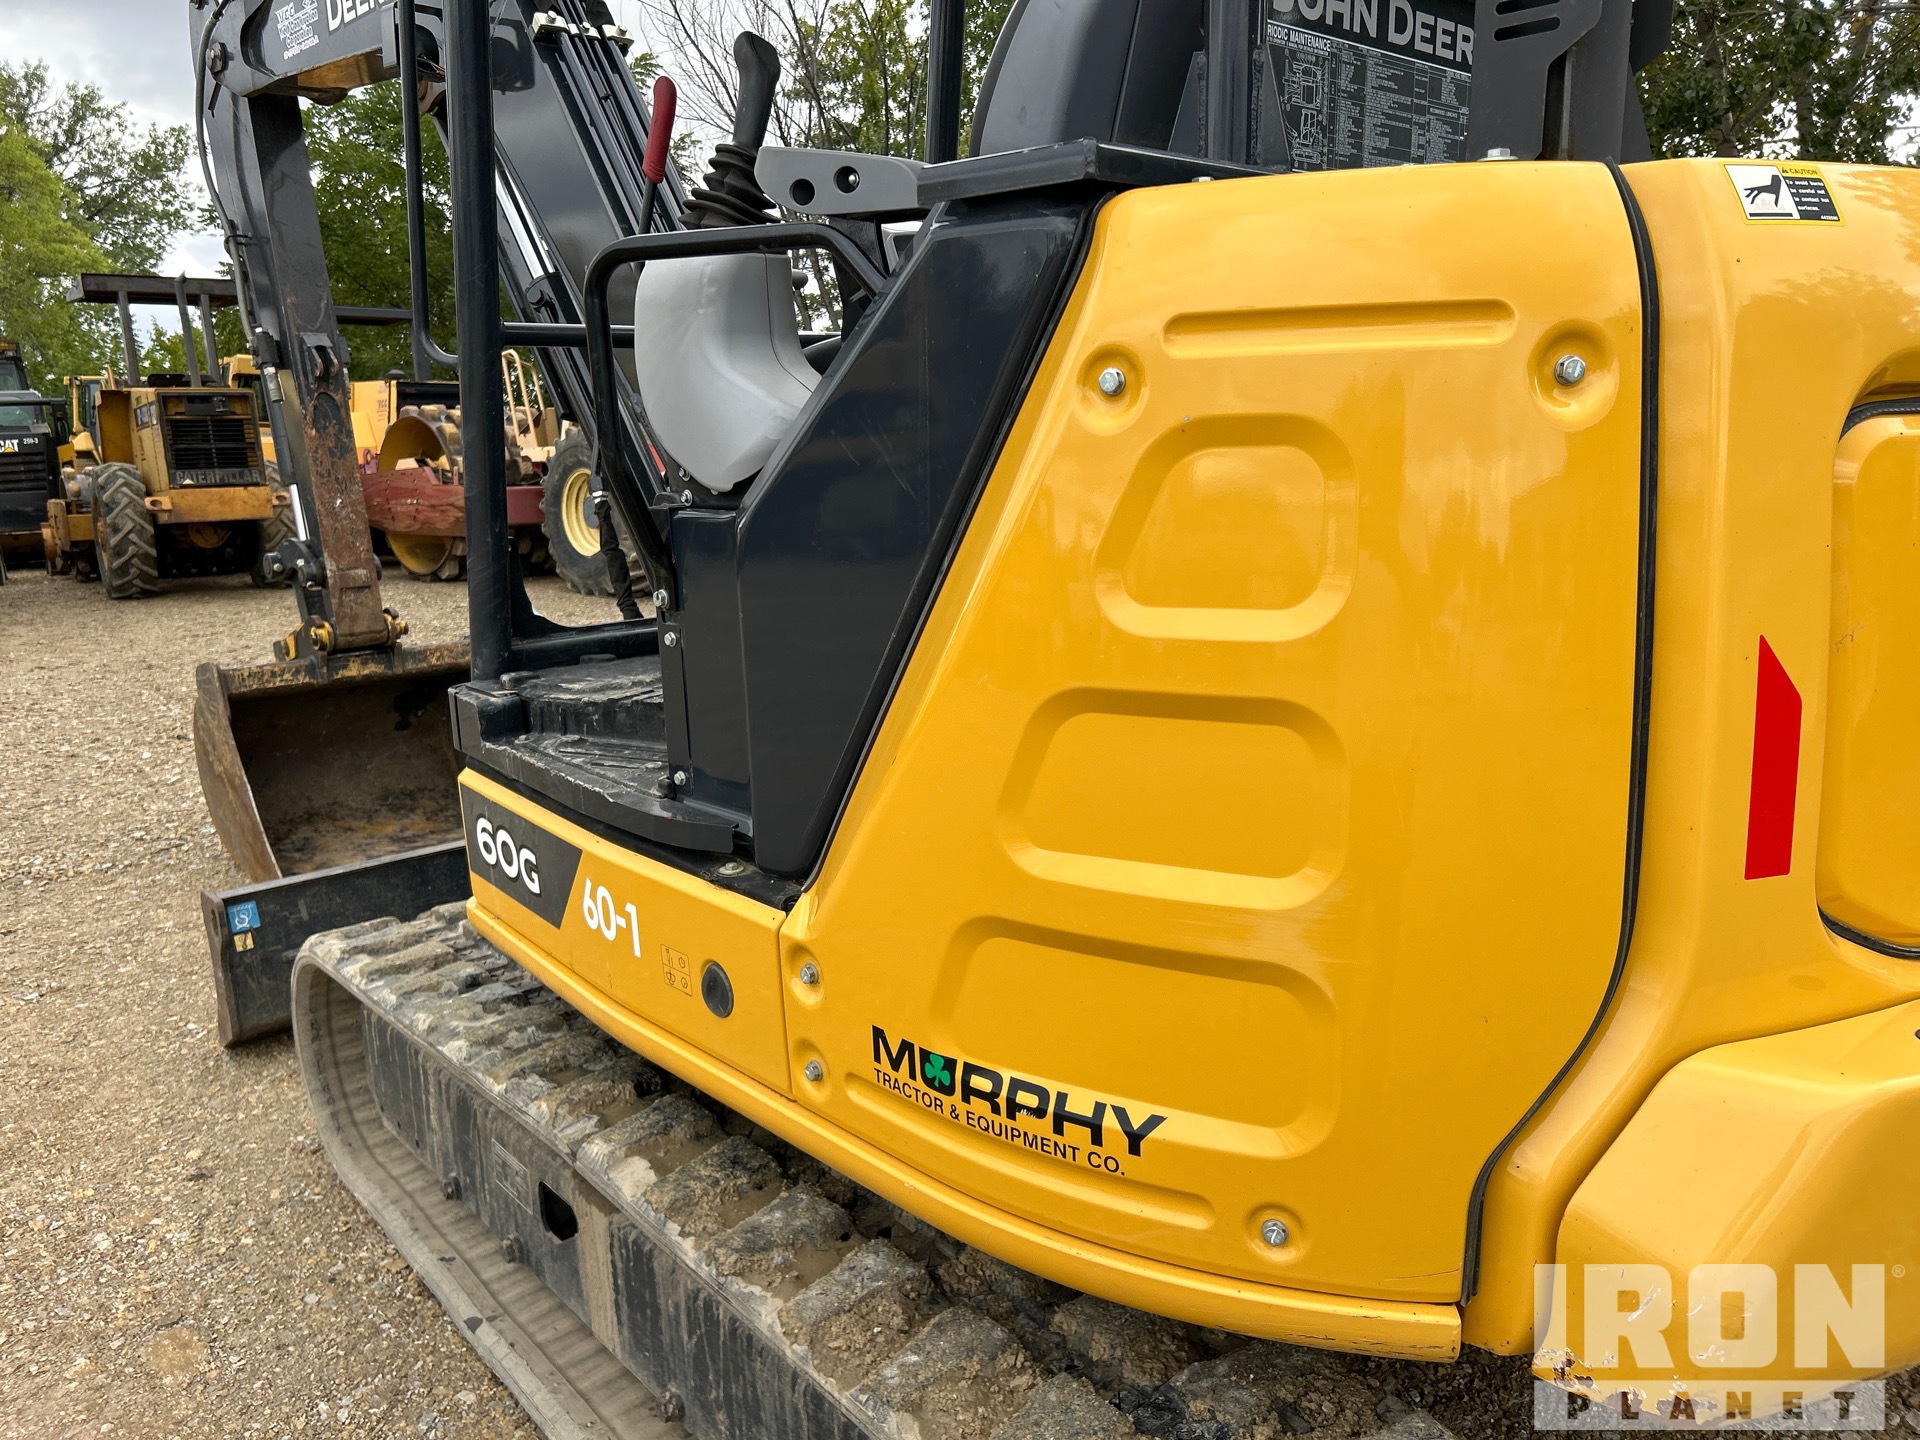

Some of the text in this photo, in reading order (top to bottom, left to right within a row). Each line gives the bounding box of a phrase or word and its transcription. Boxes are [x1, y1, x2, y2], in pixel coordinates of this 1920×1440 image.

[327, 0, 389, 32] DEE
[1290, 29, 1331, 52] MAINTENANCE
[175, 469, 261, 485] CATERPILLAR
[476, 816, 541, 894] 60G
[582, 877, 641, 958] 60-1
[872, 1024, 1168, 1158] MURPHY
[874, 1067, 1126, 1176] TRACTOR & EQUIPMENT CO.
